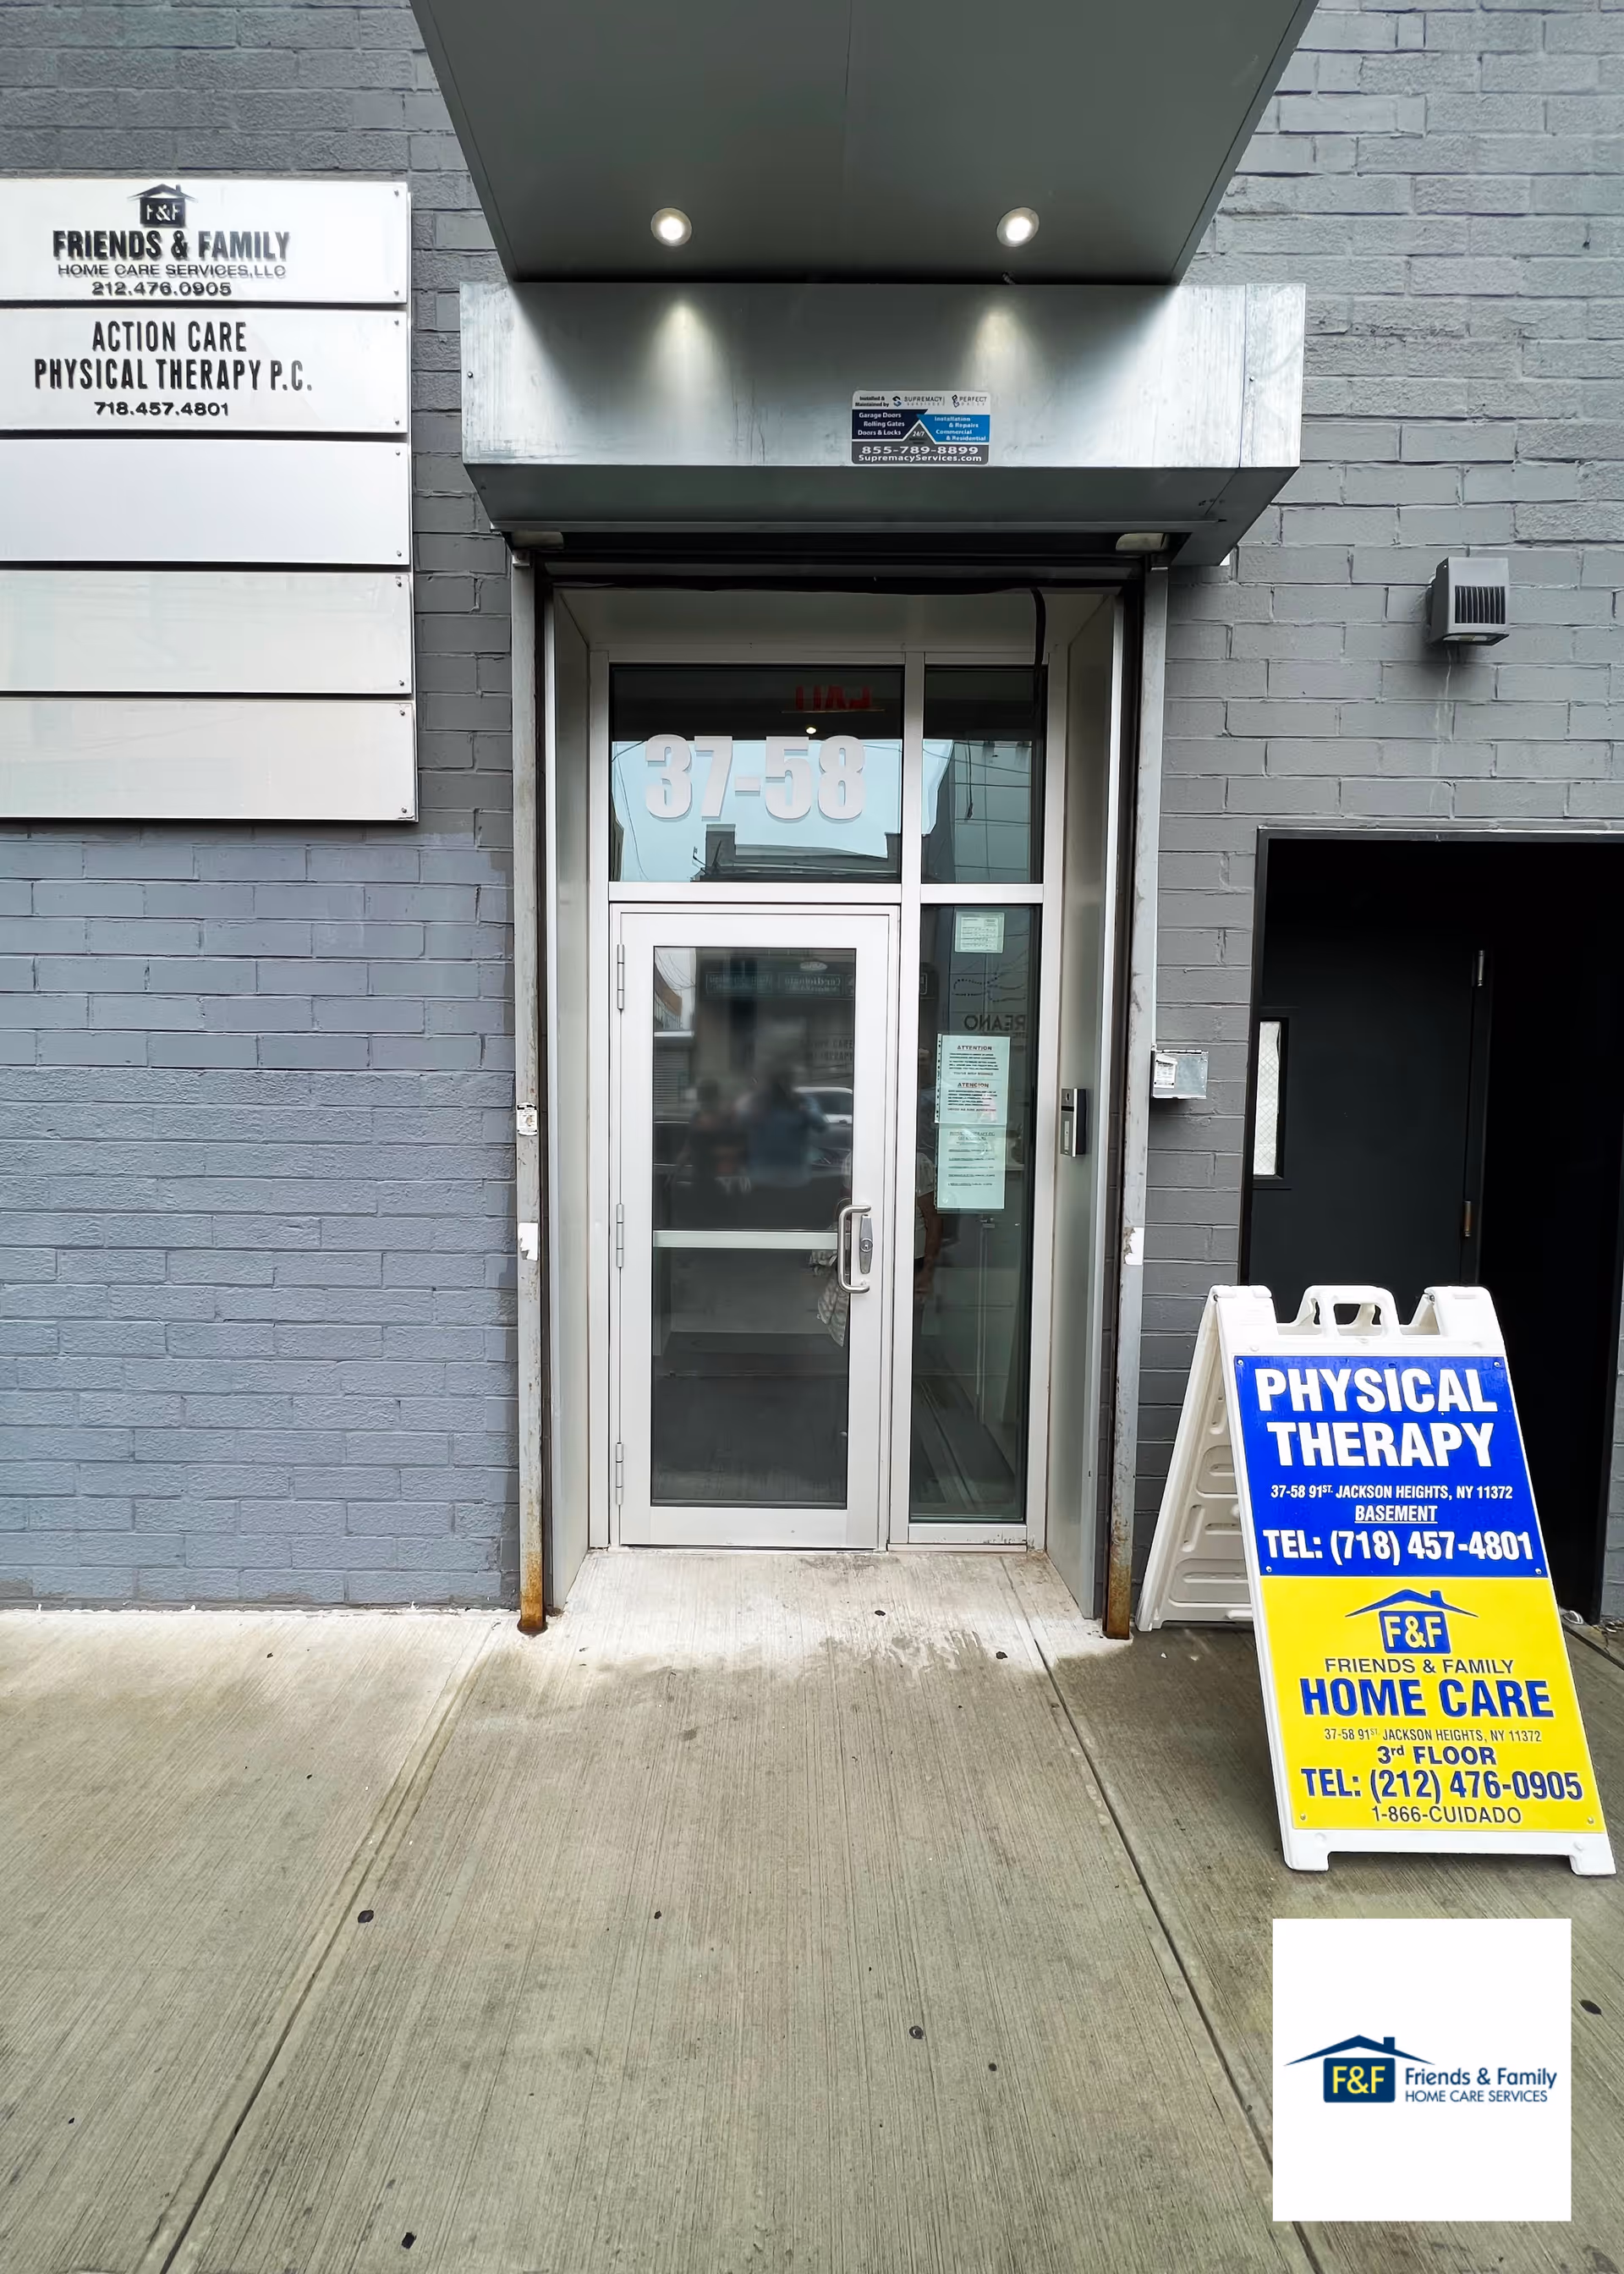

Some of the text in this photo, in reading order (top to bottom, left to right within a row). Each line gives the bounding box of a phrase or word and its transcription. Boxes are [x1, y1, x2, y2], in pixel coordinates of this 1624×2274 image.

[145, 203, 181, 222] F&F
[52, 230, 291, 260] FRIENDS & FAMILY
[58, 264, 110, 277] HOME
[114, 264, 161, 277] CARE
[91, 282, 233, 296] 212.476.0905
[92, 321, 247, 352] ACTION CARE
[35, 359, 313, 391] PHYSICAL THERAPY P.C.
[94, 402, 229, 416] 718.457.4801
[645, 733, 867, 821] 37-58
[1254, 1368, 1497, 1412] PHYSICAL
[1266, 1422, 1495, 1467] THERAPY
[1270, 1485, 1305, 1498] 37-58
[1336, 1486, 1391, 1499] JACKSON
[1396, 1486, 1452, 1501] HEIGHTS,
[1457, 1486, 1473, 1499] NY
[1477, 1486, 1512, 1499] 11372
[1355, 1505, 1438, 1522] BASEMENT
[1263, 1530, 1533, 1566] TEL: (718) 457-4801
[1384, 1616, 1443, 1648] F&F
[1325, 1658, 1514, 1673] FRIENDS & FAMILY
[1300, 1678, 1554, 1718] HOME CARE
[1325, 1728, 1355, 1740] 37-58
[1383, 1729, 1432, 1741] JACKSON
[1436, 1729, 1487, 1743] HEIGHTS,
[1490, 1730, 1506, 1741] NY
[1509, 1730, 1542, 1742] 11372
[1377, 1745, 1496, 1765] 3rd FLOOR
[1301, 1769, 1583, 1804] TEL: (212) 476-0905
[1371, 1806, 1522, 1823] 1-866-CUIDADO
